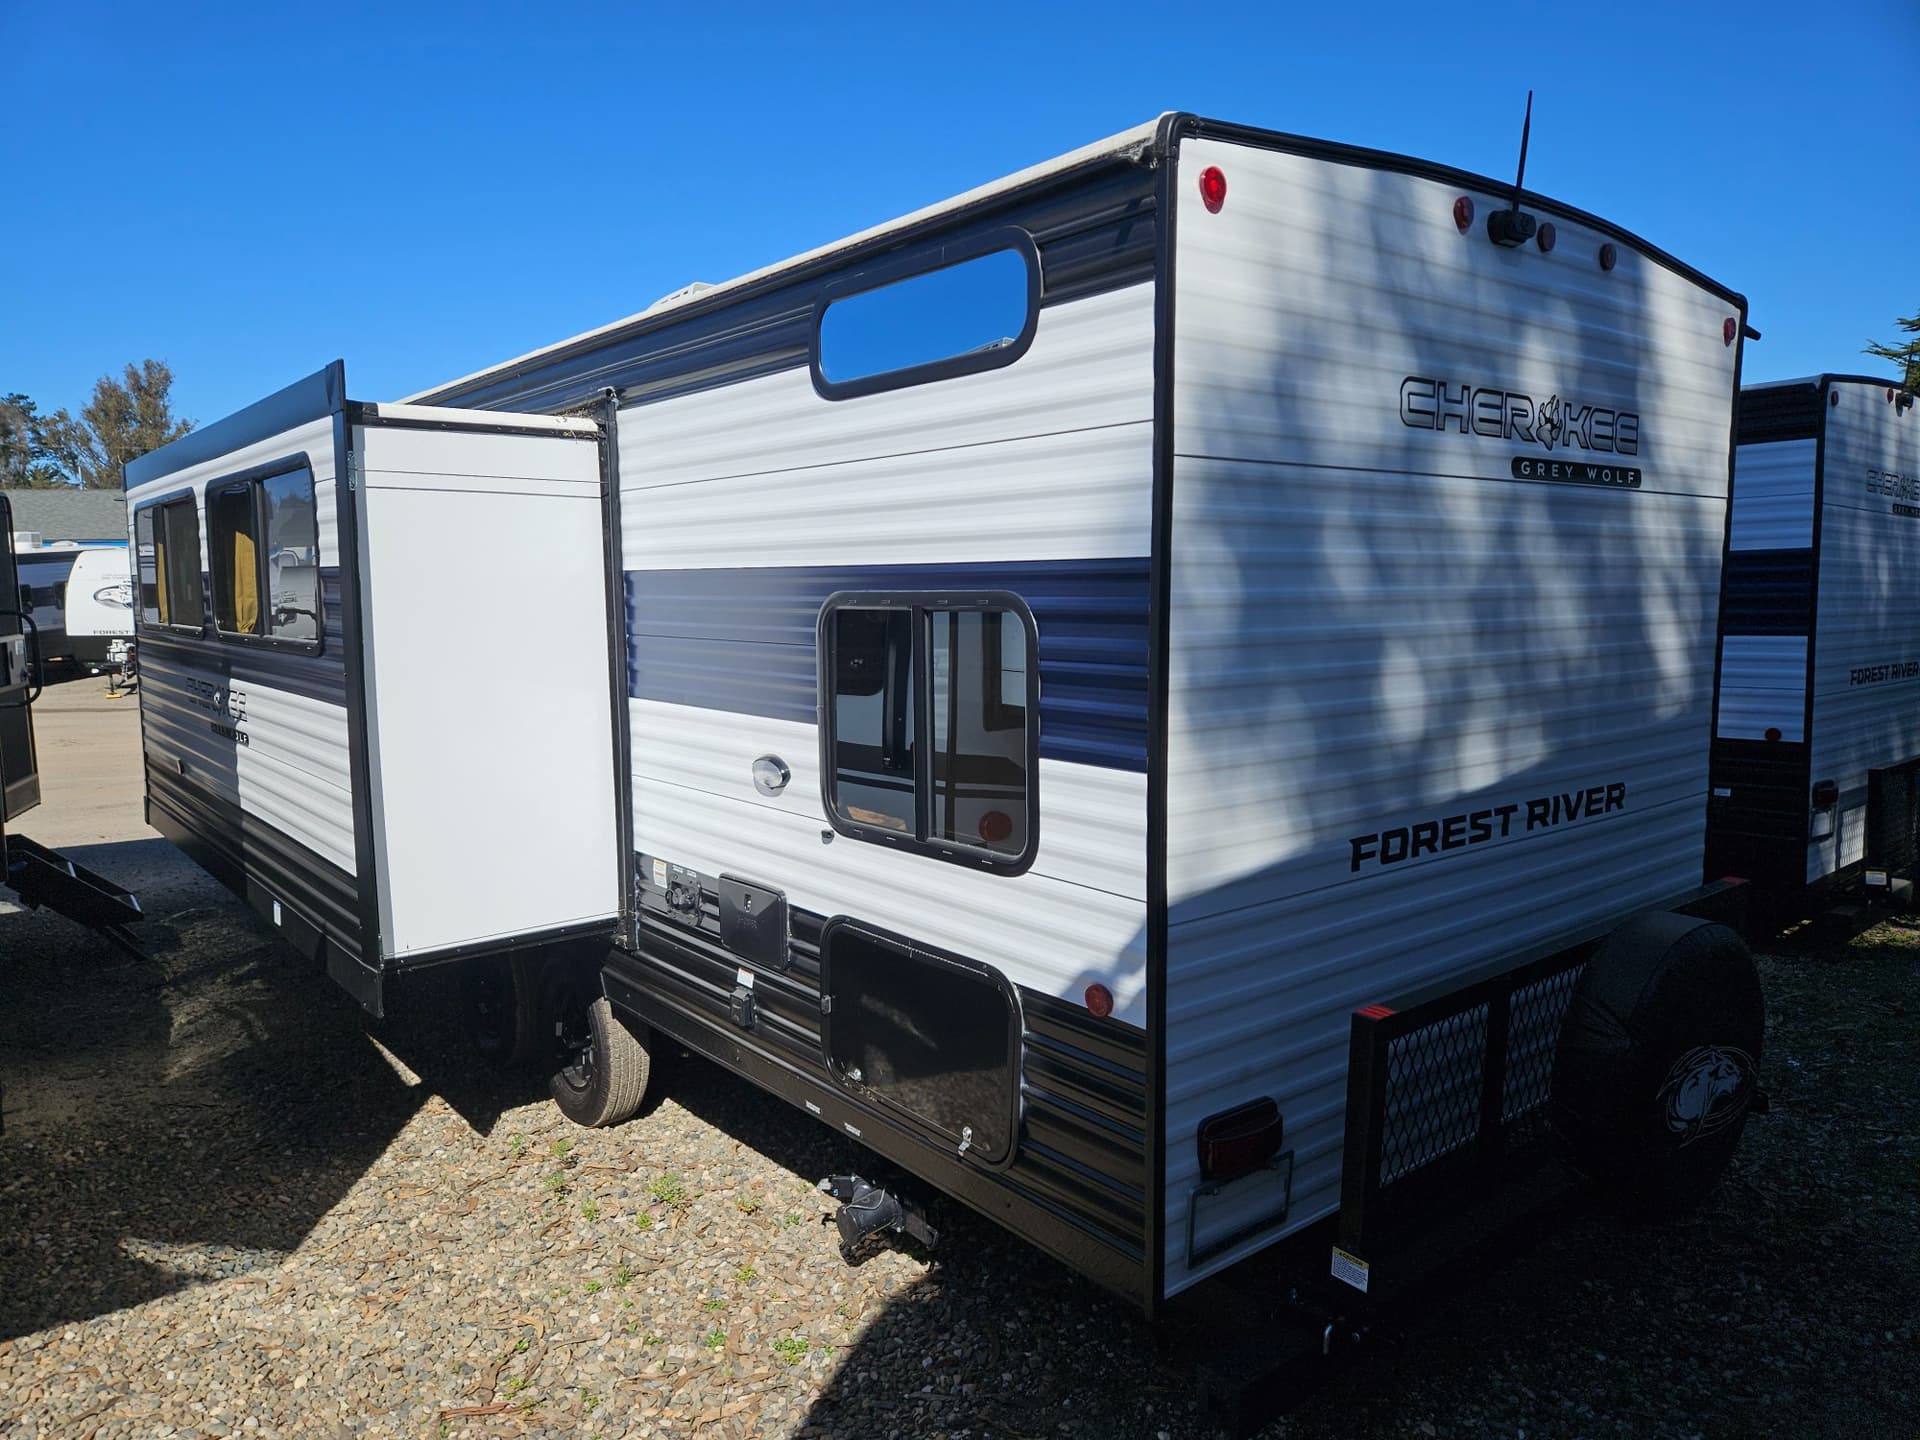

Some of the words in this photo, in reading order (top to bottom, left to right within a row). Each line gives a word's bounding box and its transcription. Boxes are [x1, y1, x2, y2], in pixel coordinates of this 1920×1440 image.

[1520, 460, 1573, 478] GREY
[1587, 468, 1636, 485] WOLF
[1849, 664, 1890, 686] FOREST
[1891, 661, 1919, 680] RIVER
[1349, 804, 1518, 872] FOREST
[1526, 782, 1626, 832] RIVER
